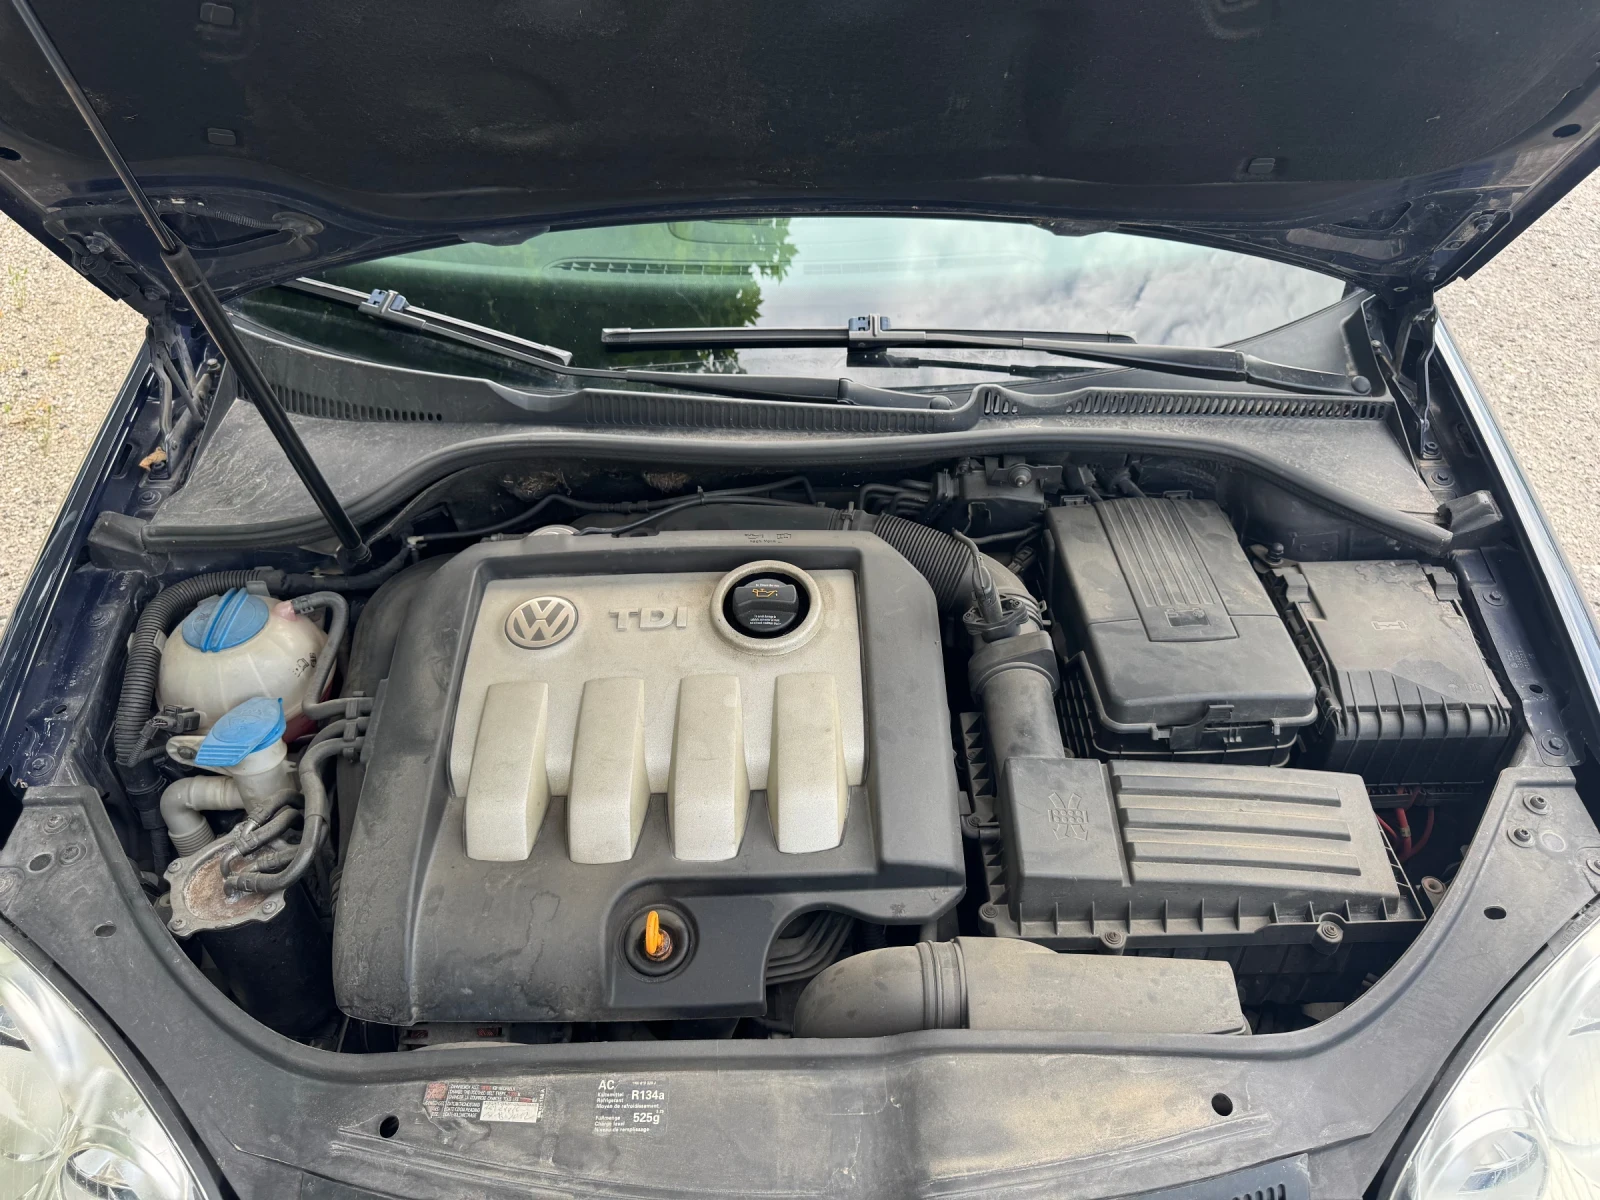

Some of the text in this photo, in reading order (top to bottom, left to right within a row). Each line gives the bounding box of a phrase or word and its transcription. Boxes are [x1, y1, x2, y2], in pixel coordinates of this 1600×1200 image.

[608, 606, 688, 632] TDI
[598, 1079, 615, 1090] AC
[631, 1089, 665, 1101] R134a
[633, 1112, 660, 1125] 525g
